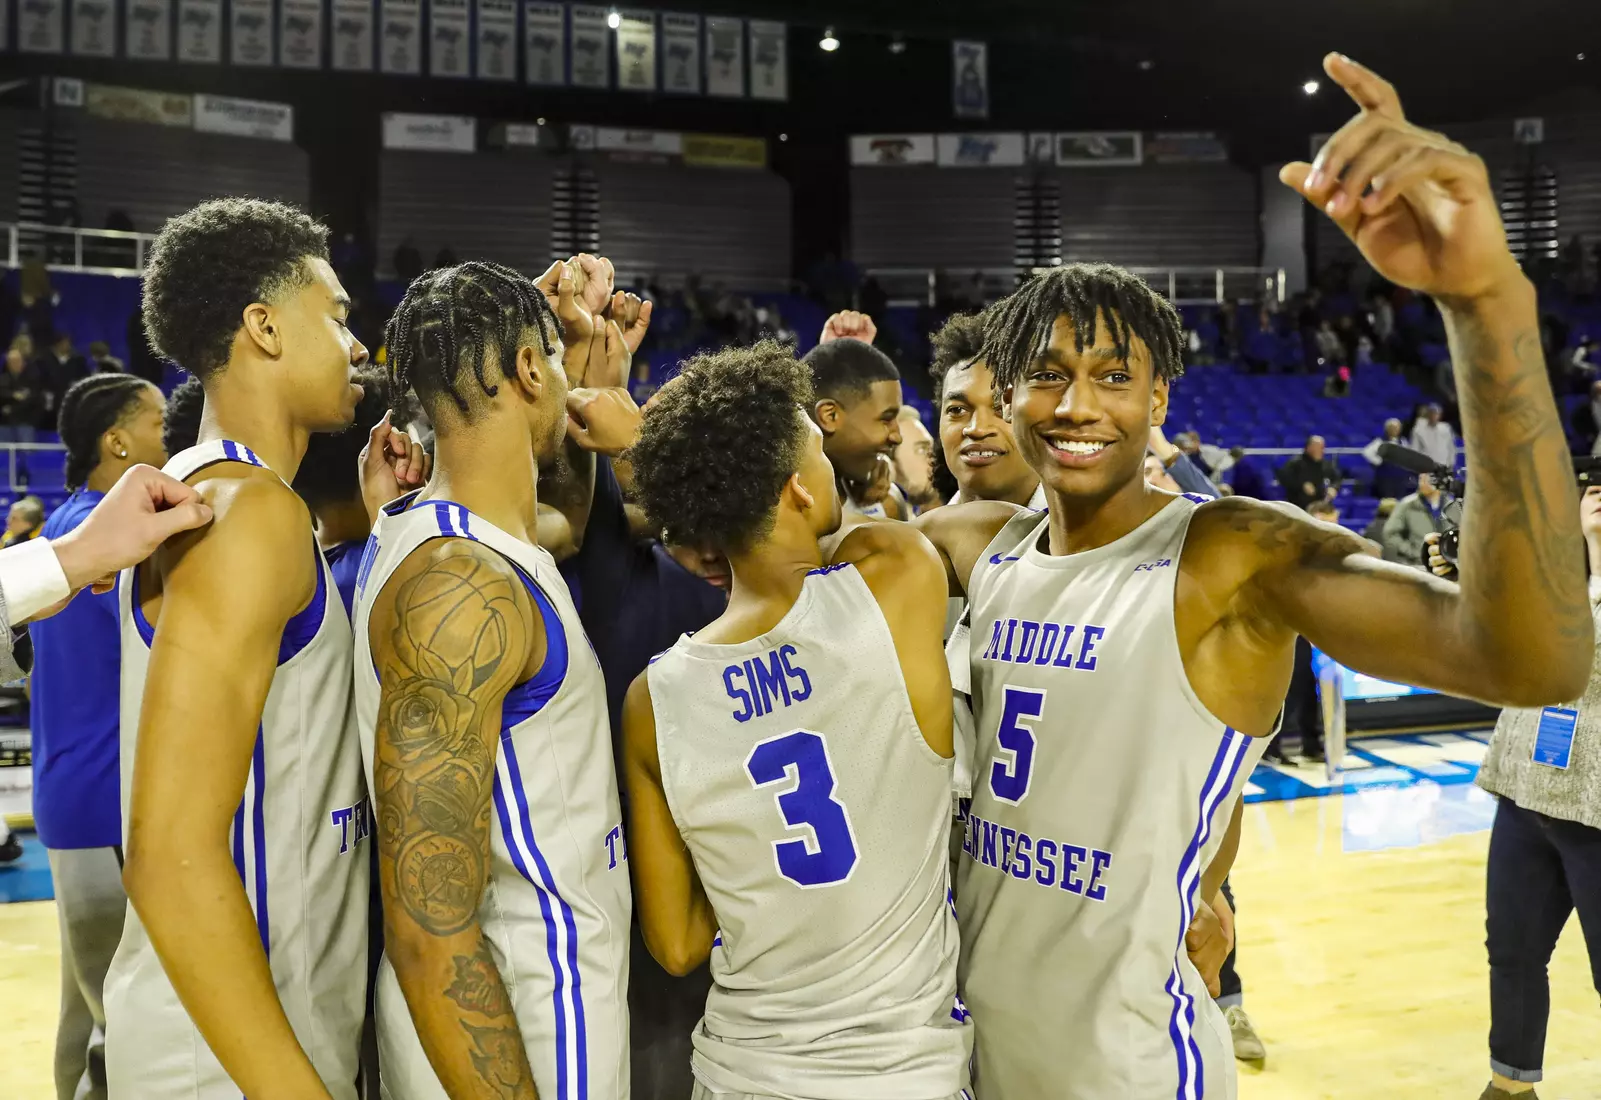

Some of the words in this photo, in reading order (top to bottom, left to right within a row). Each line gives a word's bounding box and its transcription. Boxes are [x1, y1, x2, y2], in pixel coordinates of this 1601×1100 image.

[722, 644, 813, 723] SIMS
[982, 618, 1106, 672] MIDDLE
[988, 684, 1047, 807] 5
[743, 727, 861, 889] 3
